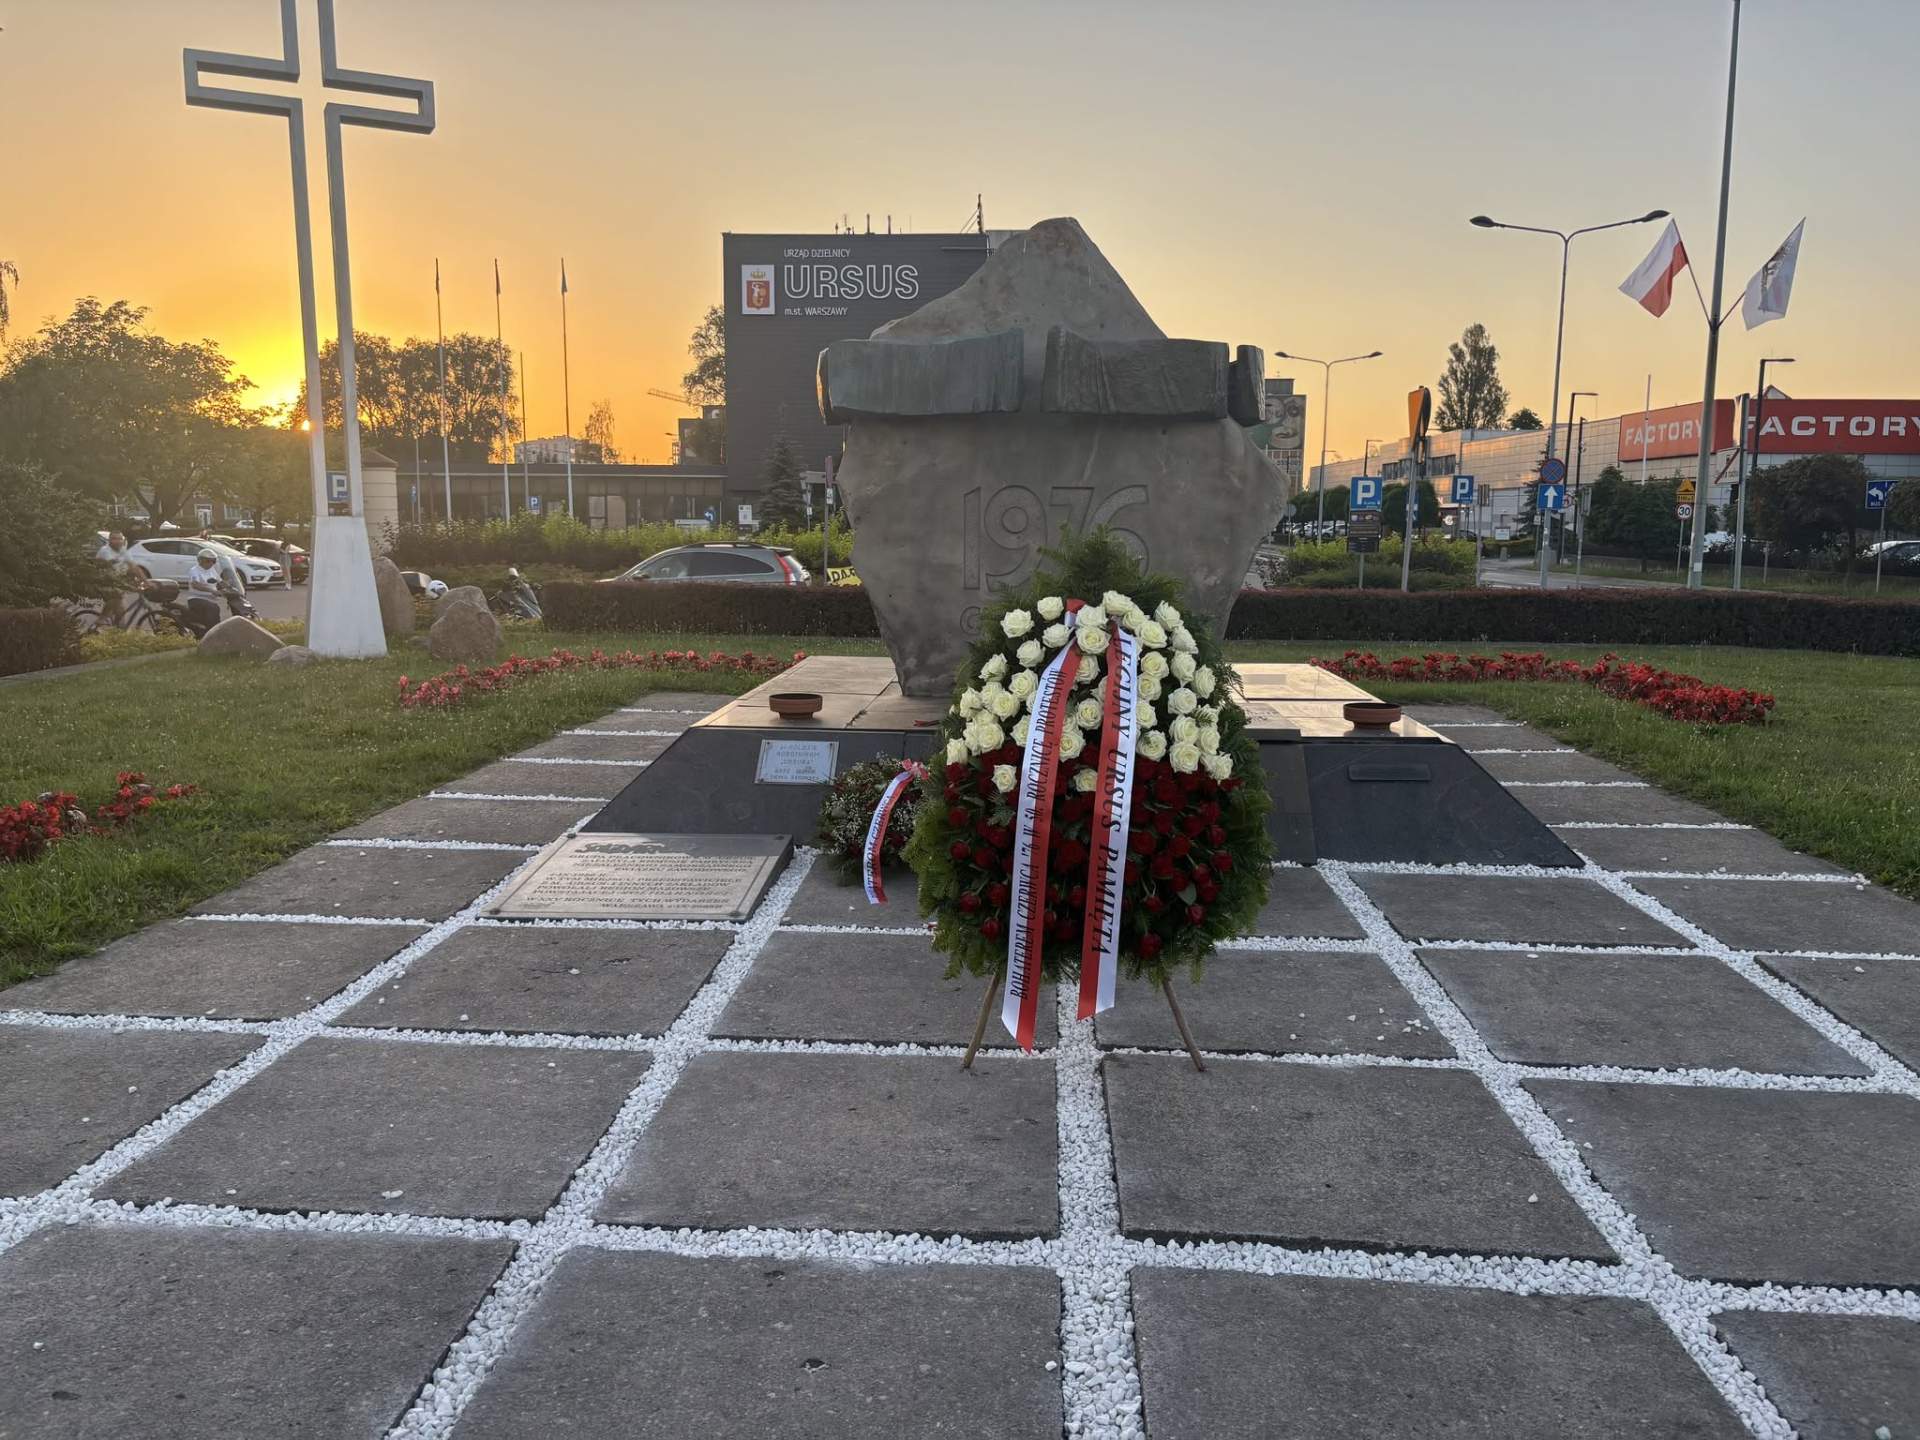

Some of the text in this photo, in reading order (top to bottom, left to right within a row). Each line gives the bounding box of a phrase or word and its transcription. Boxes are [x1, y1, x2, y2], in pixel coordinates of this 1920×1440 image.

[784, 248, 850, 259] URZĄD DZIELNICY
[784, 264, 919, 299] URSUS
[804, 307, 848, 315] WARSZAWY
[1357, 480, 1375, 505] P
[1456, 478, 1469, 500] P
[1679, 506, 1690, 516] 30
[1089, 637, 1131, 954] LEGIJNY URSUS PAMIĘTA
[1017, 863, 1039, 920] CZERWCA
